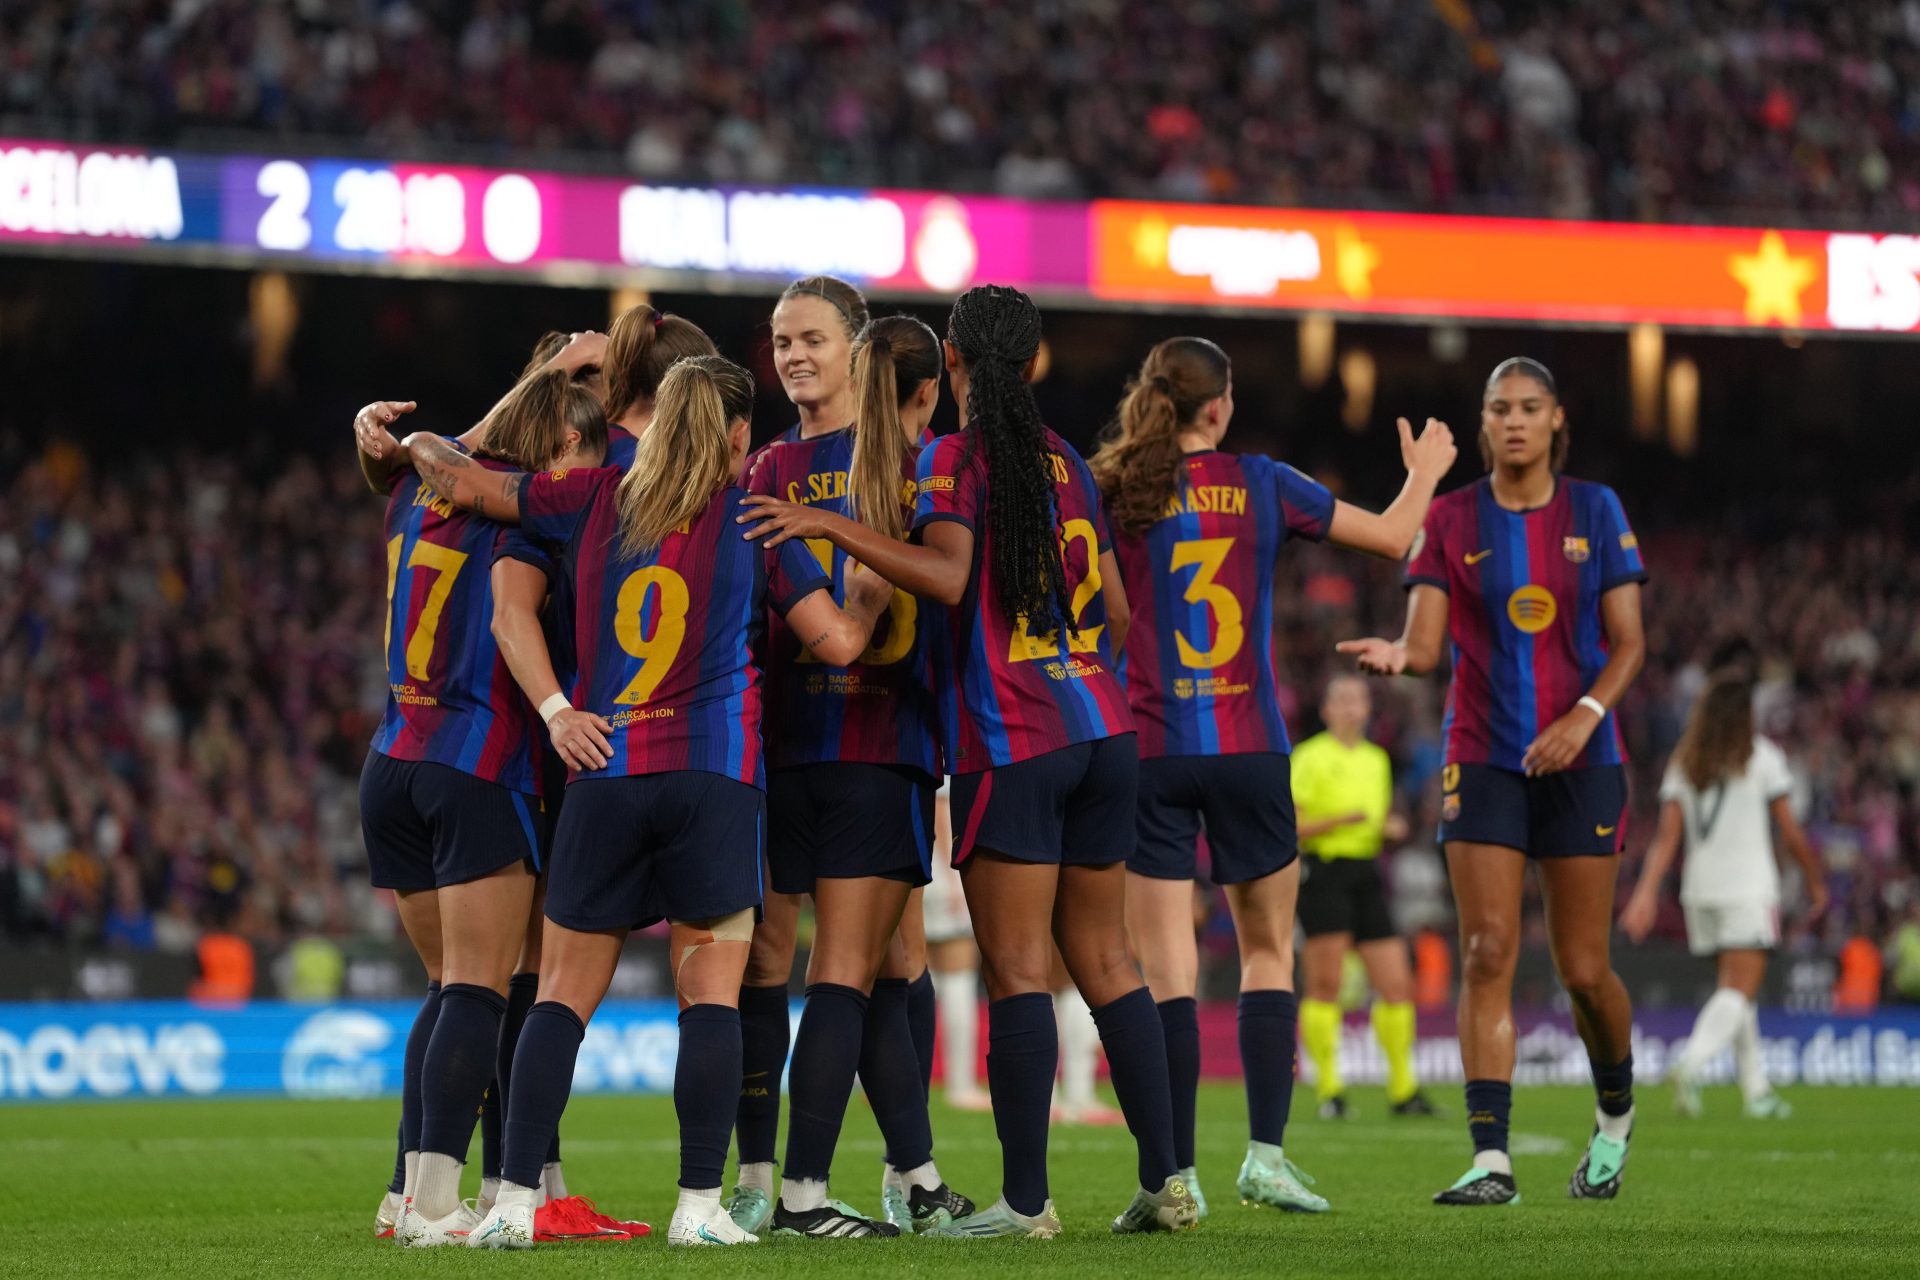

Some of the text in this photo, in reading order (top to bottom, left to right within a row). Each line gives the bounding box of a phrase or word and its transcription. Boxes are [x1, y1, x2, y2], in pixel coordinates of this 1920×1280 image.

[256, 160, 311, 250] 2
[482, 173, 541, 263] 0
[1186, 486, 1246, 516] ASTEN
[385, 533, 469, 682] 17
[614, 565, 689, 705] 9
[1169, 537, 1244, 669] 3
[394, 693, 437, 706] UNDATION
[828, 684, 889, 695] FOUNDATION
[740, 1087, 769, 1098] ARÇA
